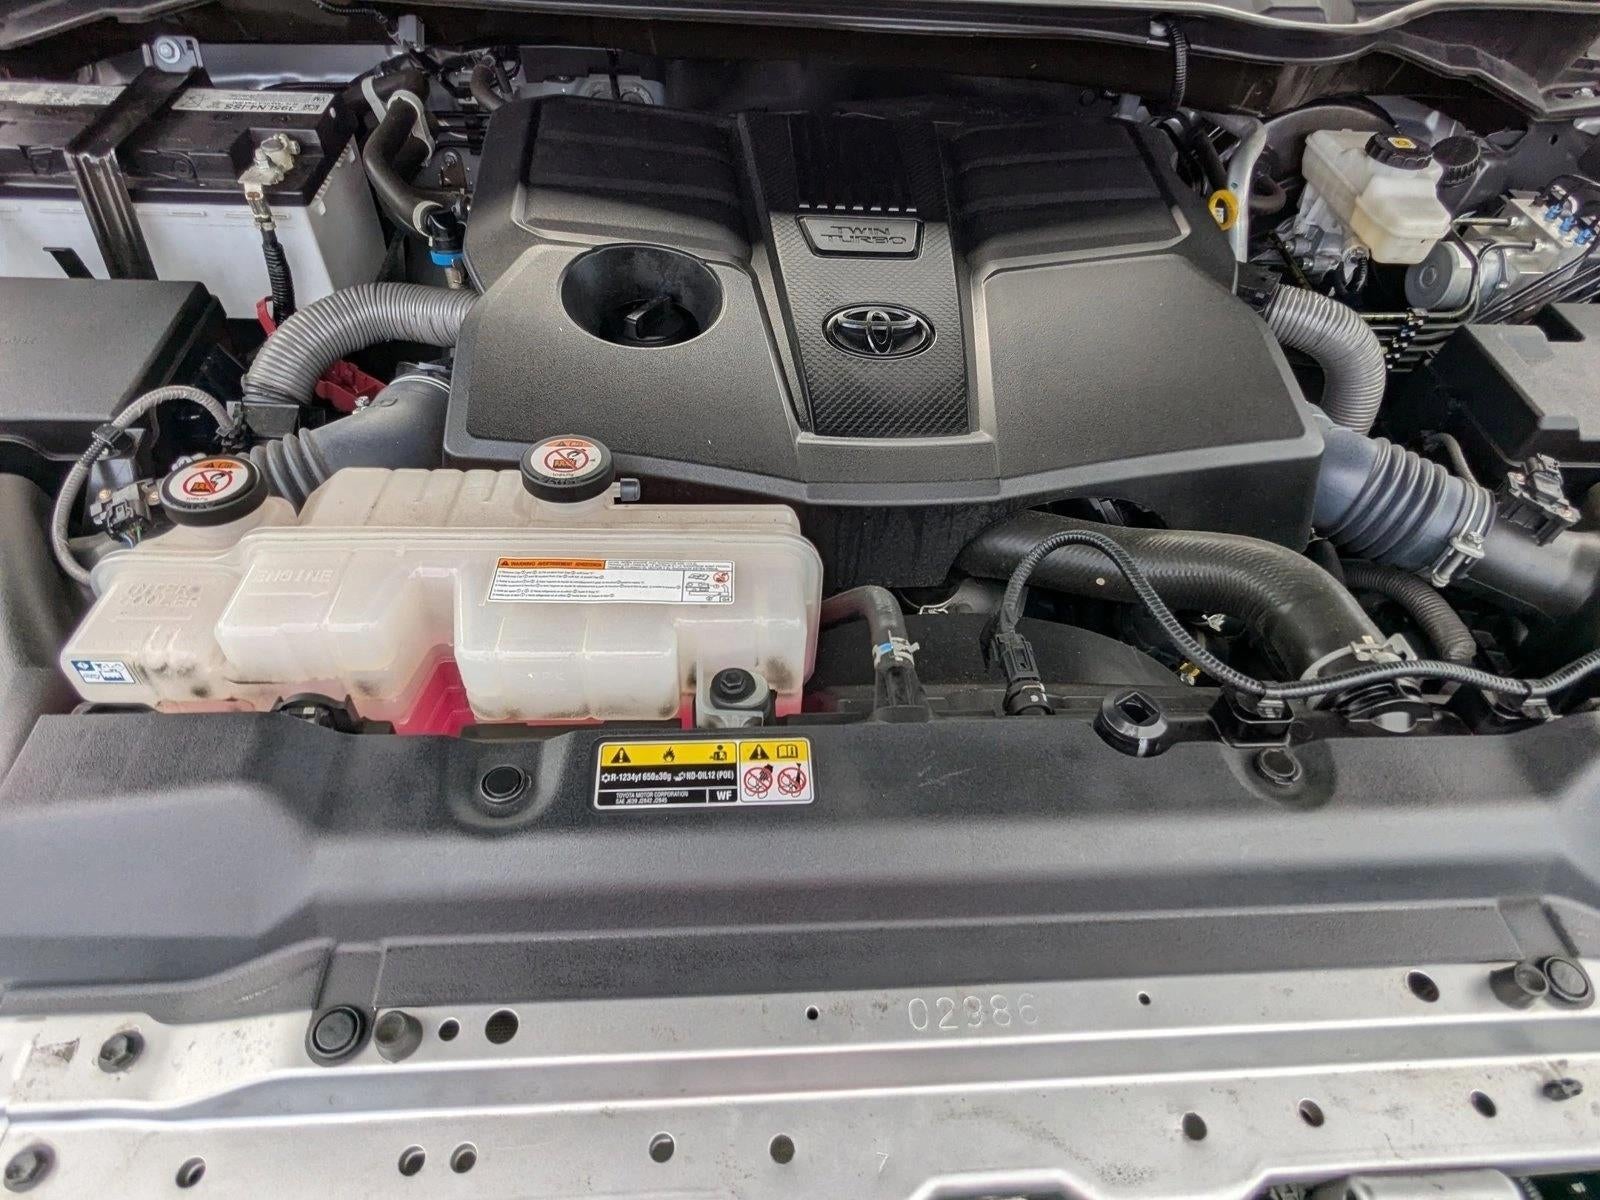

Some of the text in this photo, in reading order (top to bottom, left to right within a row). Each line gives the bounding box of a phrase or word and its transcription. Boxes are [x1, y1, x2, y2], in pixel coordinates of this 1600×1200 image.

[830, 225, 890, 235] TWIN
[820, 234, 907, 244] TURBO
[654, 790, 688, 798] CORPORATION
[716, 790, 732, 801] WF
